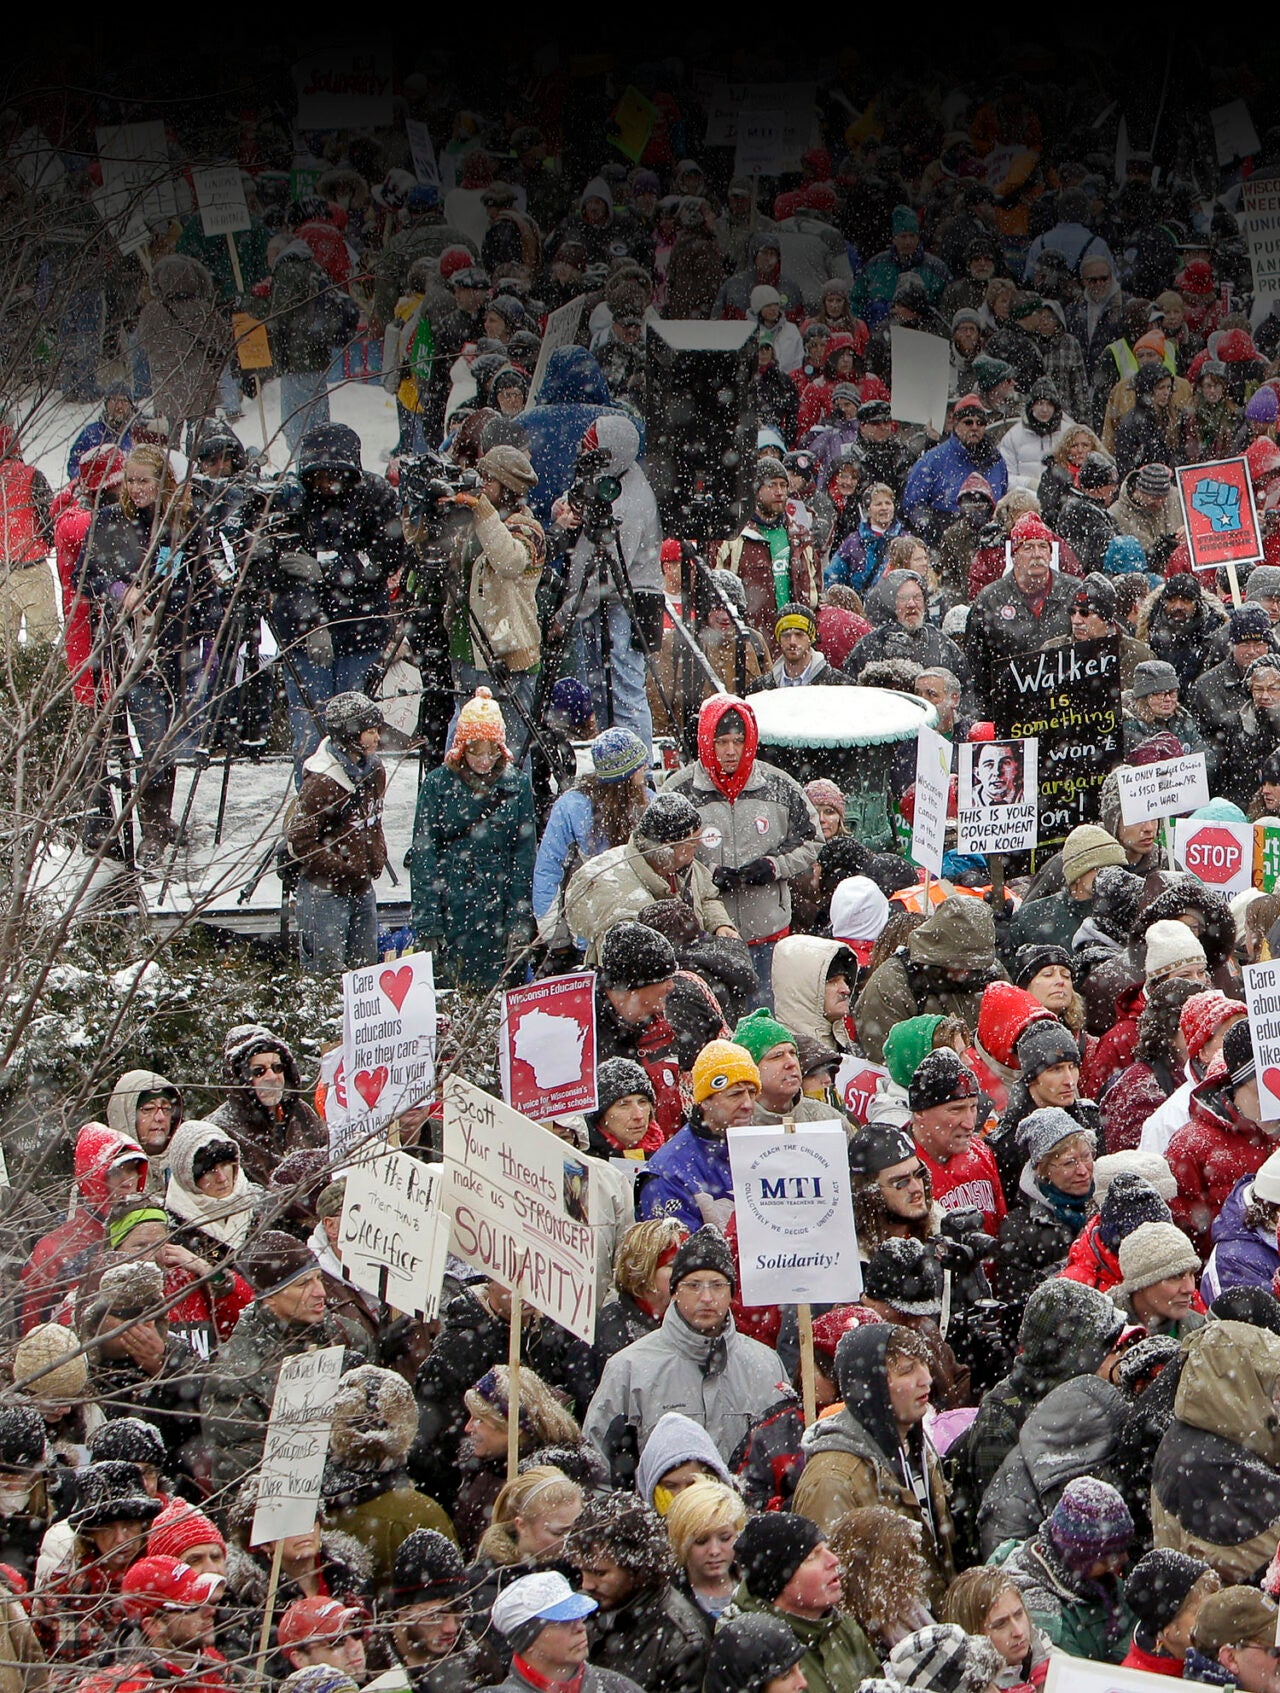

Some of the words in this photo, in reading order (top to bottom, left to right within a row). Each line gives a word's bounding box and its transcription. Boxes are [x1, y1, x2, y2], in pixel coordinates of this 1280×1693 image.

[1010, 648, 1117, 694] Walker
[1011, 708, 1116, 738] something
[1121, 774, 1133, 784] The
[1134, 769, 1154, 782] ONLY
[1155, 765, 1178, 777] Budget
[1179, 761, 1201, 772] Crisis
[917, 773, 944, 800] Wisconsin
[1138, 783, 1156, 796] $150
[1158, 774, 1197, 792] Billion/YR
[928, 795, 938, 809] the
[1147, 799, 1158, 812] for
[1159, 792, 1179, 805] WAR!
[918, 808, 938, 828] canary
[959, 810, 982, 824] THIS
[990, 808, 999, 822] IS
[1006, 805, 1036, 820] YOUR
[926, 824, 937, 840] the
[960, 819, 1034, 840] GOVERNMENT
[970, 839, 987, 853] ON
[995, 836, 1025, 850] KOCH
[1188, 843, 1240, 869] STOP
[352, 973, 374, 995] Care
[1249, 968, 1276, 990] Care
[508, 988, 549, 1006] Wisconsin
[550, 978, 591, 996] Educators
[353, 996, 381, 1020] about
[355, 1018, 402, 1045] educators
[354, 1050, 373, 1069] like
[374, 1044, 396, 1063] they
[397, 1039, 418, 1059] care
[1258, 1045, 1280, 1067] like
[390, 1064, 403, 1086] for
[406, 1061, 427, 1082] your
[517, 1102, 522, 1111] A
[522, 1097, 539, 1110] voice
[540, 1095, 550, 1106] for
[550, 1085, 588, 1102] Wisconsin's
[546, 1102, 567, 1115] public
[448, 1116, 490, 1165] Your
[499, 1142, 557, 1202] threats
[750, 1160, 760, 1170] WE
[760, 1146, 780, 1161] TEACH
[800, 1145, 830, 1168] CHILDREN
[758, 1176, 824, 1199] MTI
[744, 1182, 769, 1226] COLLECTIVELY
[771, 1223, 781, 1233] WE
[785, 1227, 809, 1235] DECIDE
[816, 1208, 834, 1227] UNITED
[832, 1196, 839, 1206] WE
[453, 1168, 485, 1198] make
[490, 1190, 505, 1209] us
[513, 1190, 596, 1275] STRONGER!
[455, 1205, 593, 1335] SOLIDARITY!
[755, 1252, 840, 1270] Solidarity!
